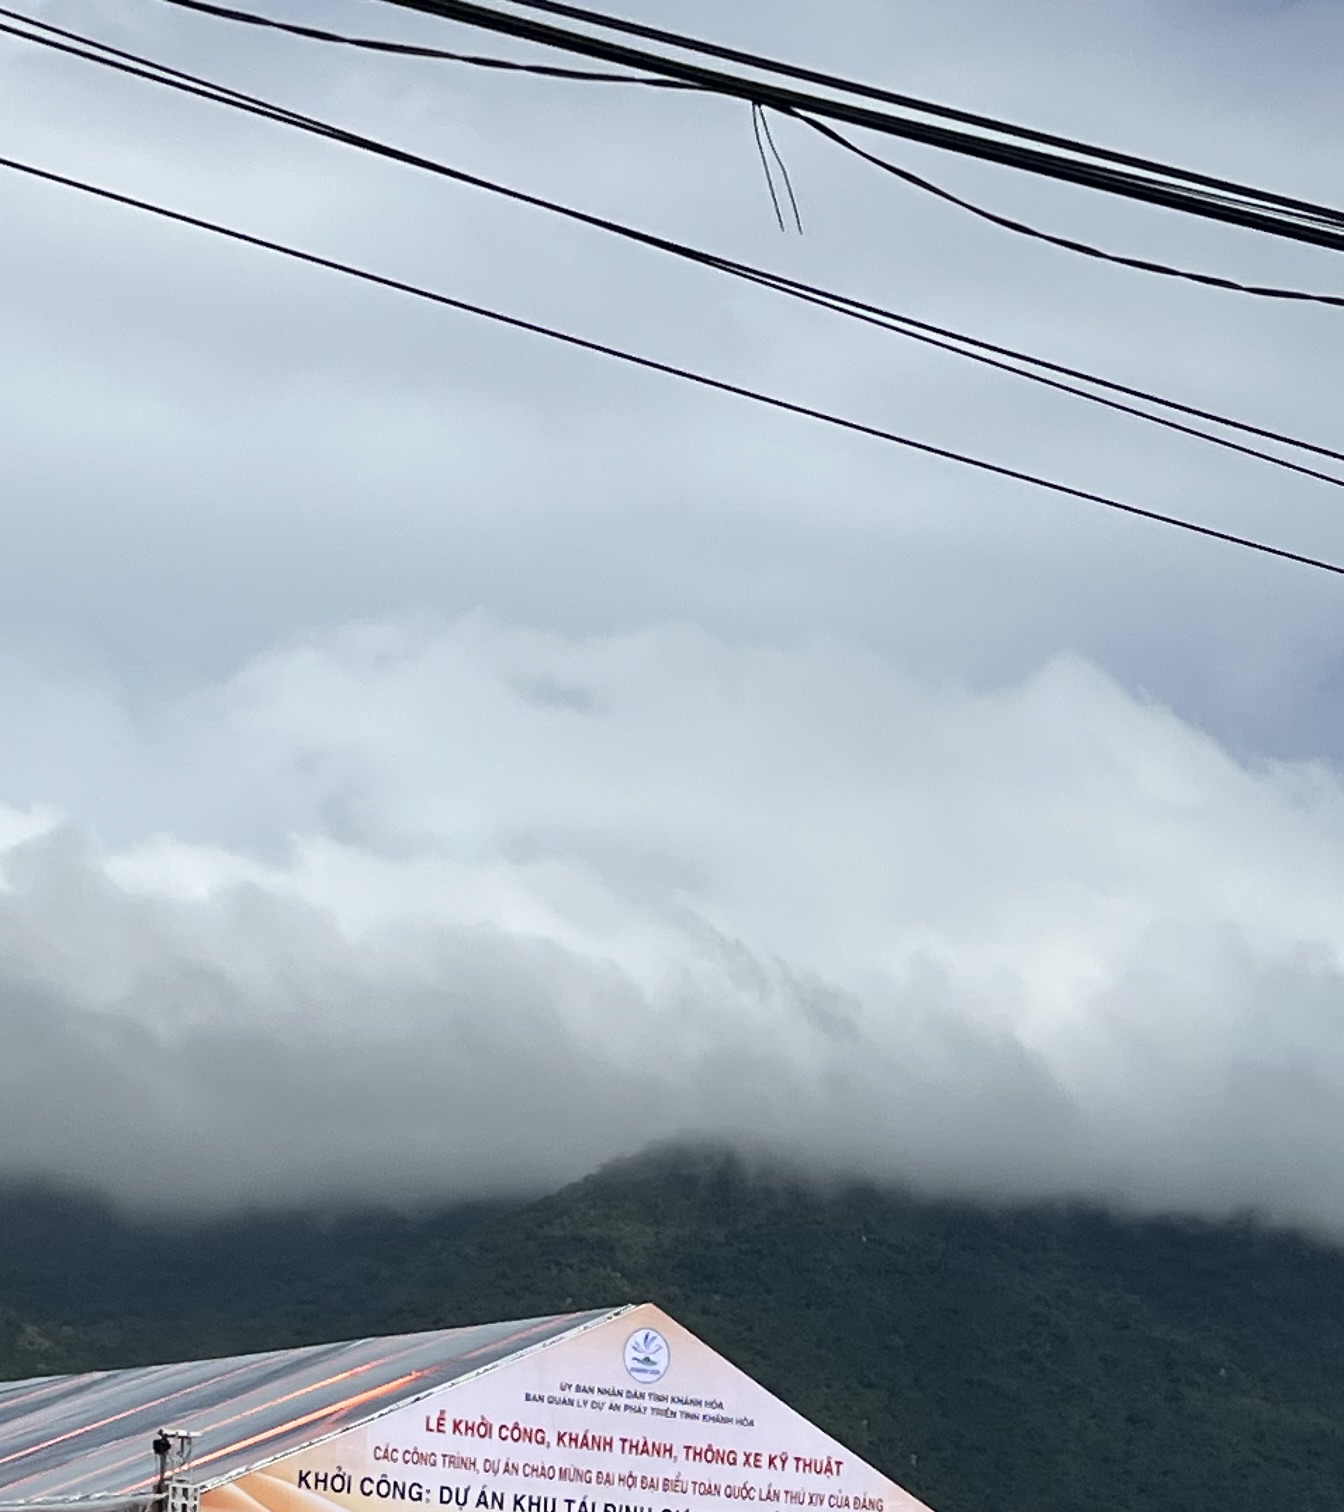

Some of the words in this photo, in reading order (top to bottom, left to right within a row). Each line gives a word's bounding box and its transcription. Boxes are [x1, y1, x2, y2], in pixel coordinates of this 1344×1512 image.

[425, 1409, 446, 1434] LỄ
[453, 1414, 492, 1439] KHỞI
[498, 1422, 551, 1449] CÔNG,
[556, 1429, 613, 1453] KHÁNH
[619, 1436, 678, 1463] THÀNH,
[683, 1443, 737, 1467] THÔNG
[743, 1451, 763, 1469] XE
[767, 1452, 789, 1471] KỸ
[794, 1456, 844, 1479] THUẬT
[298, 1466, 352, 1494] KHỞI
[359, 1473, 431, 1503] CÔNG:
[439, 1485, 471, 1511] DỰ
[475, 1484, 504, 1511] ÁN
[374, 1446, 398, 1463] CÁC
[402, 1446, 437, 1467] CÔNG
[441, 1451, 480, 1474] TRÌNH,
[483, 1458, 501, 1477] DỰ
[502, 1459, 519, 1477] ÁN
[522, 1463, 556, 1481] CHÀO
[558, 1464, 592, 1485] MỪNG
[618, 1470, 637, 1492] HỘI
[662, 1472, 688, 1495] BIỂU
[692, 1480, 721, 1498] TOÀN
[724, 1480, 756, 1501] QUỐC
[807, 1492, 825, 1507] XIV
[828, 1489, 850, 1510] CỦA
